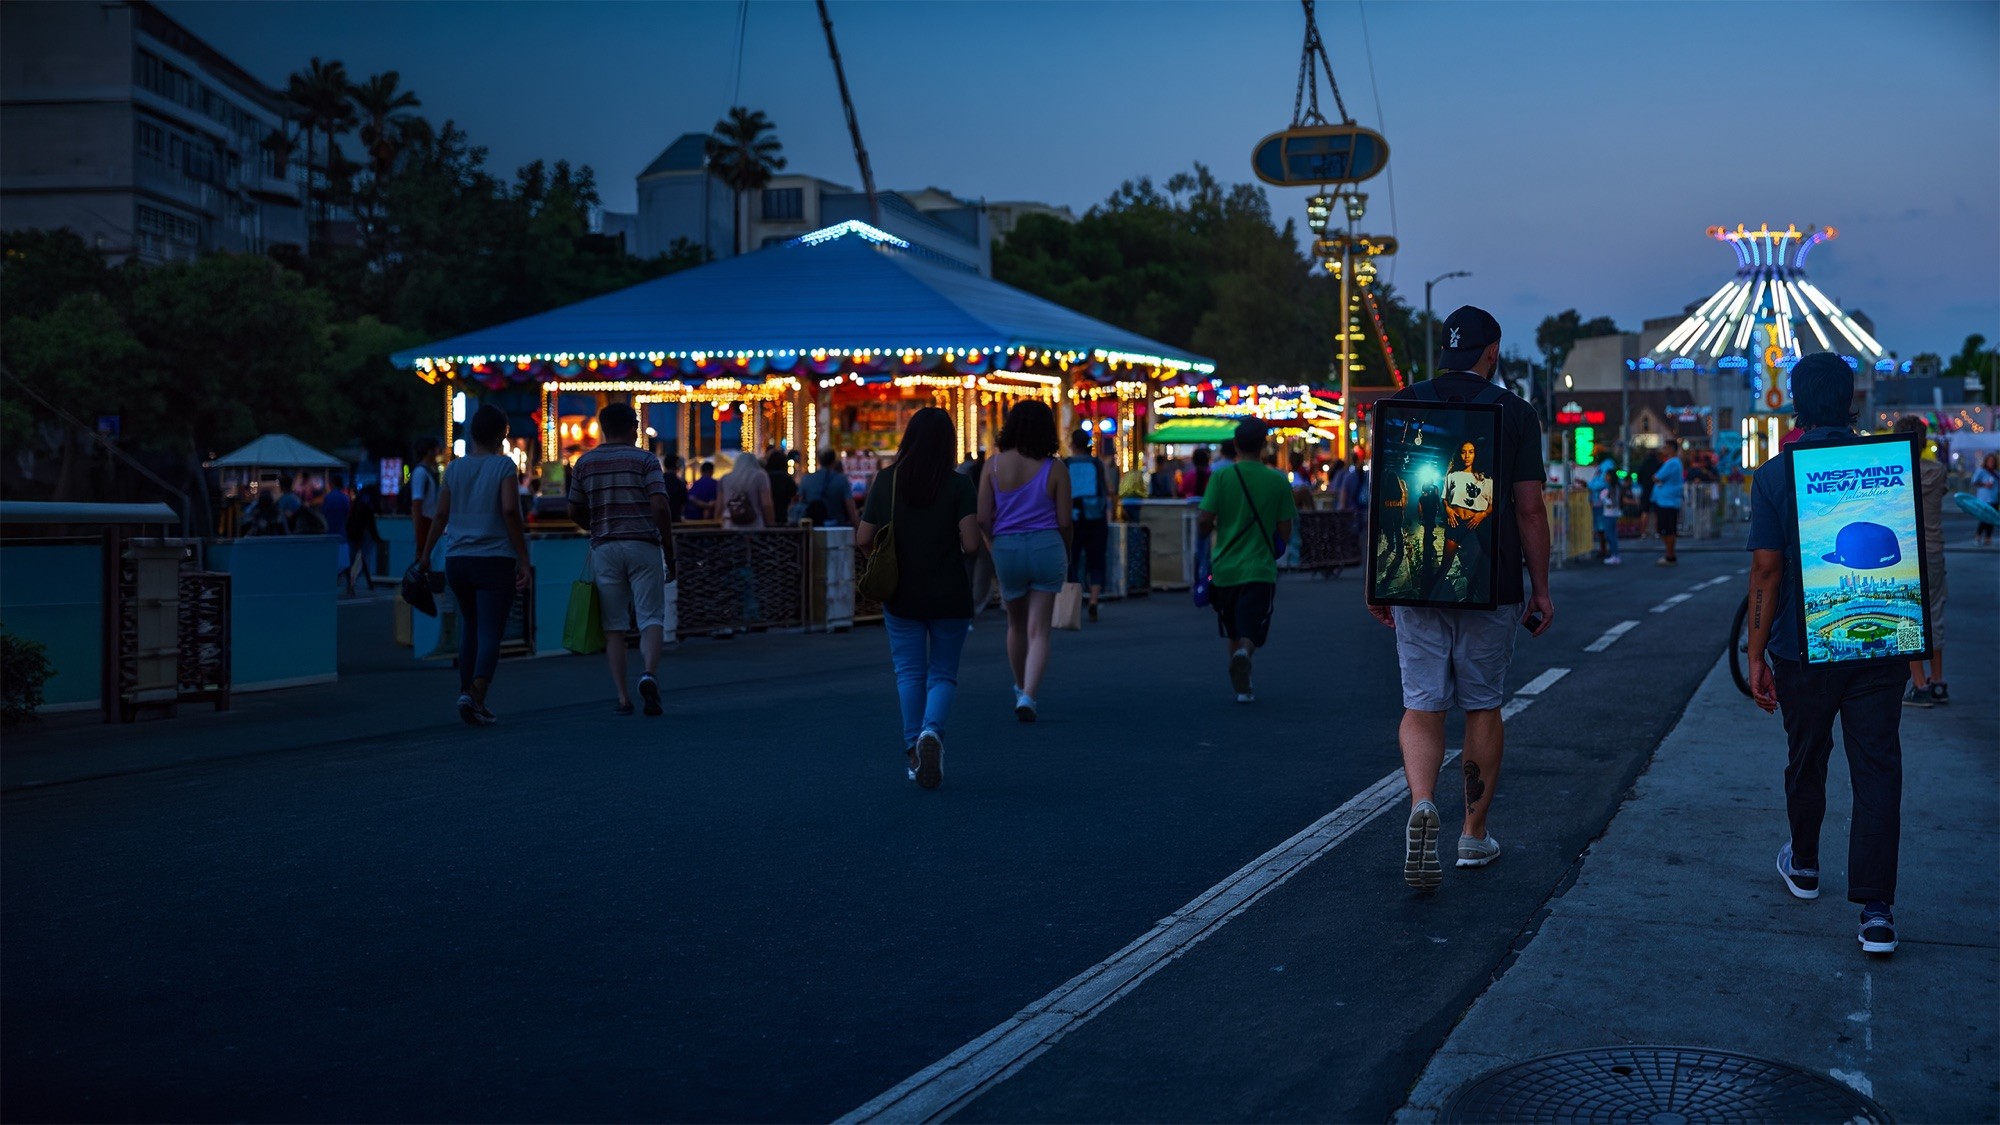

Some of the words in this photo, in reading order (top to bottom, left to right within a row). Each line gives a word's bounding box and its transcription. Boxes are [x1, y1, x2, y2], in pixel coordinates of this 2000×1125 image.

[1806, 465, 1904, 482] WISEMIND
[1807, 479, 1858, 494] NEW
[1862, 476, 1904, 489] ERA
